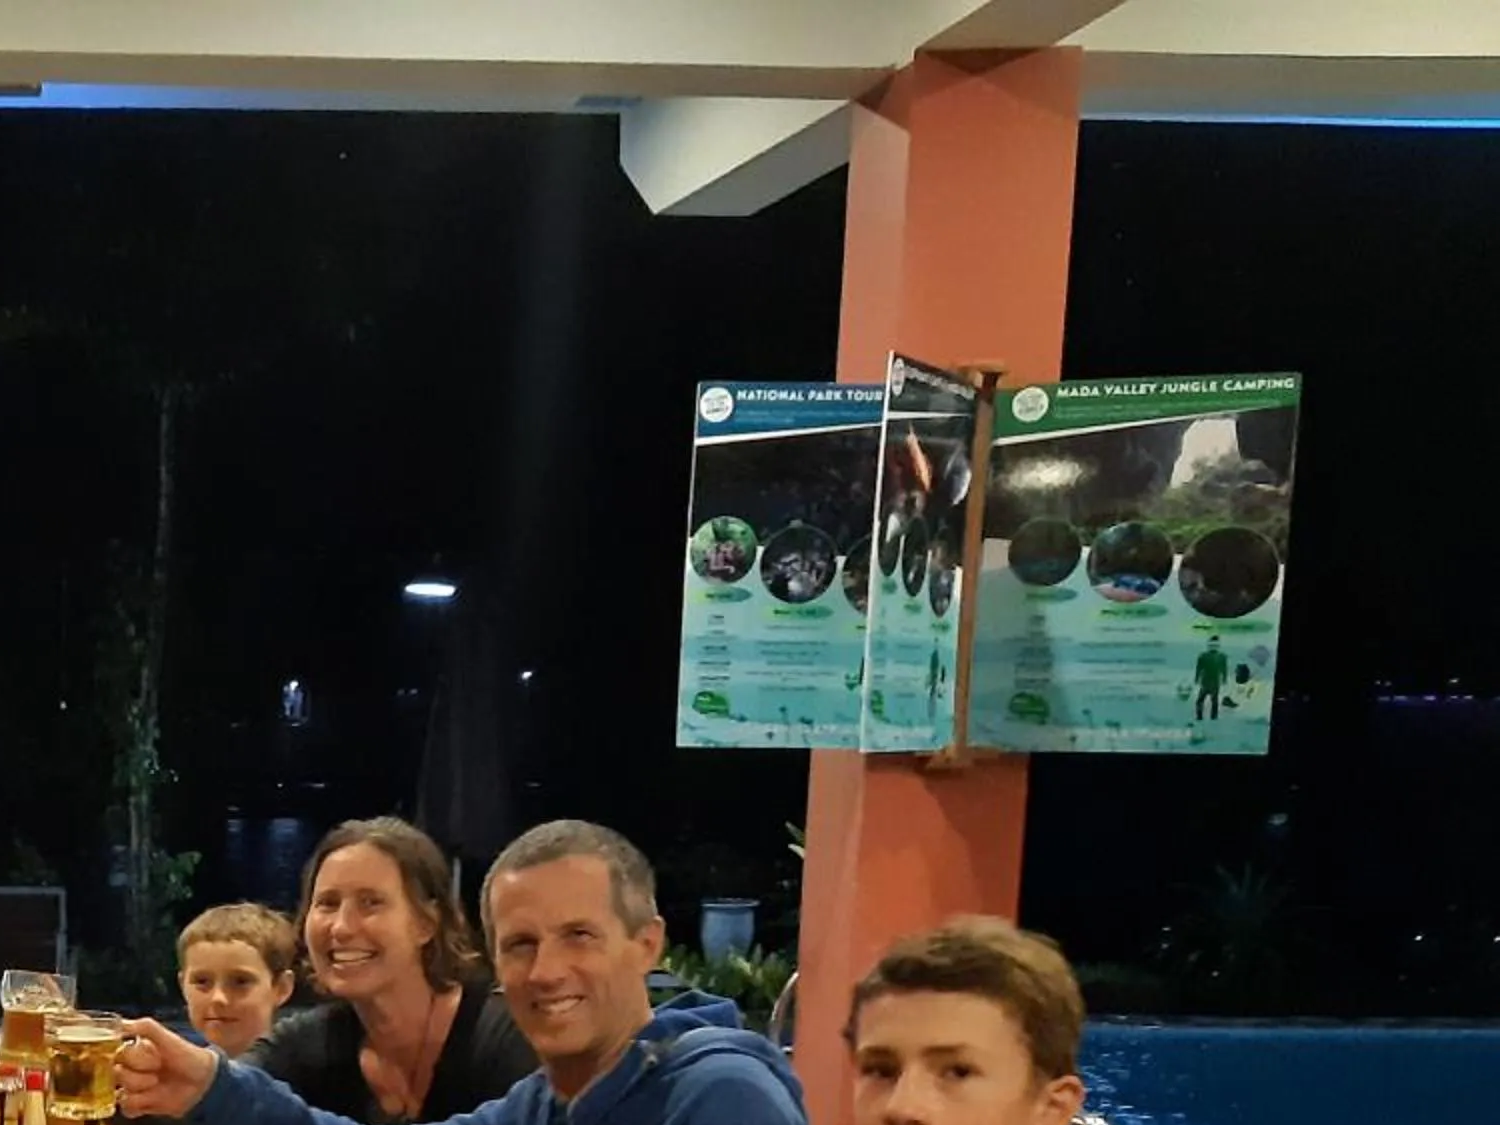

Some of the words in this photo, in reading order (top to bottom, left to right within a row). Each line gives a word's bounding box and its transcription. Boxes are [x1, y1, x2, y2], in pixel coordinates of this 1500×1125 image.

[736, 389, 804, 401] NATIONAL
[807, 389, 843, 401] PARK
[847, 389, 884, 401] TOUR
[1056, 386, 1100, 397] MADA
[1103, 384, 1157, 395] VALLEY
[1160, 381, 1218, 394] JUNGLE
[1223, 378, 1295, 391] CAMPING
